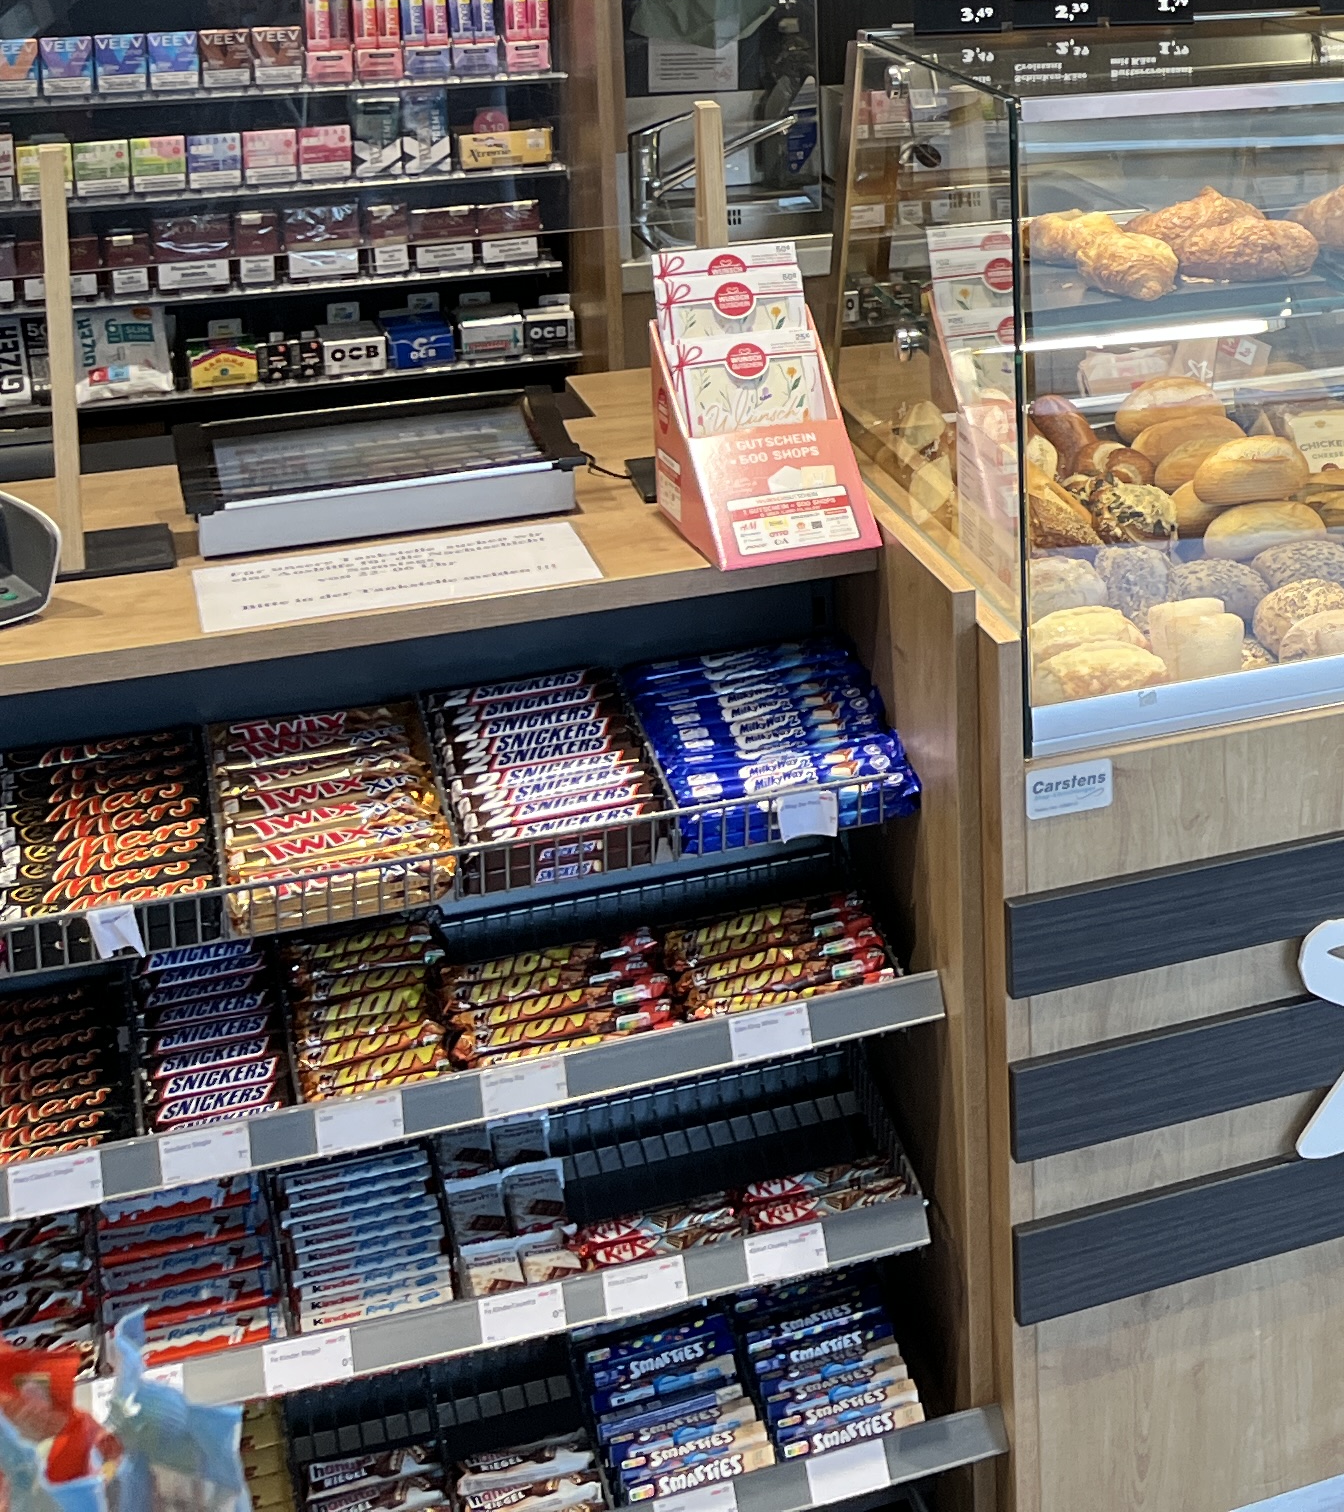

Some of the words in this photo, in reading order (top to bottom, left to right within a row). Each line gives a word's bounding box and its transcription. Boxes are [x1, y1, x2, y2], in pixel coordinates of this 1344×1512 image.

[960, 7, 994, 23] 3,49
[1055, 2, 1089, 21] 2,39
[150, 34, 196, 47] VEEV
[202, 32, 248, 46] VEEV
[530, 325, 567, 339] OCB
[331, 345, 379, 362] OCB
[736, 432, 817, 451] GUTSCHEIN
[739, 452, 768, 465] 500
[772, 446, 820, 461] SHOPS
[1312, 451, 1344, 460] CHEESE
[496, 719, 604, 752] SNICKERS
[1032, 773, 1107, 795] Carstens
[56, 818, 207, 862] Mars
[52, 838, 205, 883] Mars
[42, 859, 198, 904] Mars
[708, 947, 794, 978] LION
[489, 1011, 587, 1046] LION
[163, 1038, 266, 1072] SNICKERS
[334, 1043, 438, 1086] LION
[168, 1060, 272, 1094] SNICKERS
[163, 1085, 267, 1120] SNICKERS
[629, 1342, 705, 1379] SMARTIES
[812, 1412, 895, 1453] SMARTIES
[658, 1453, 743, 1497] SMARTIES
